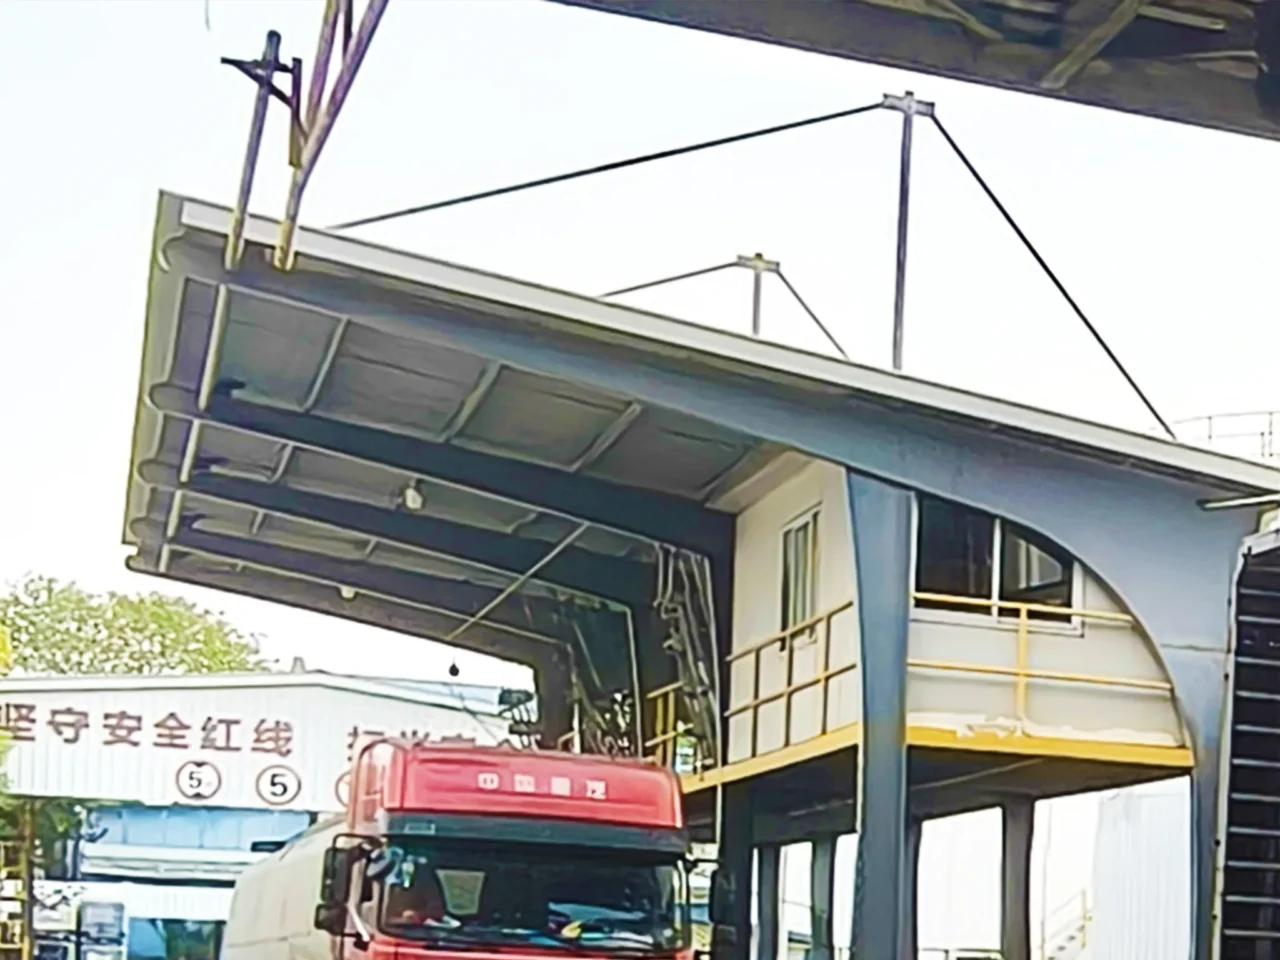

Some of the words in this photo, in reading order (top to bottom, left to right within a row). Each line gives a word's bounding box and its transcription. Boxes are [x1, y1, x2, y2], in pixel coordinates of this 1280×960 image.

[0, 702, 294, 757] 坚守安全红线
[270, 773, 288, 797] 5
